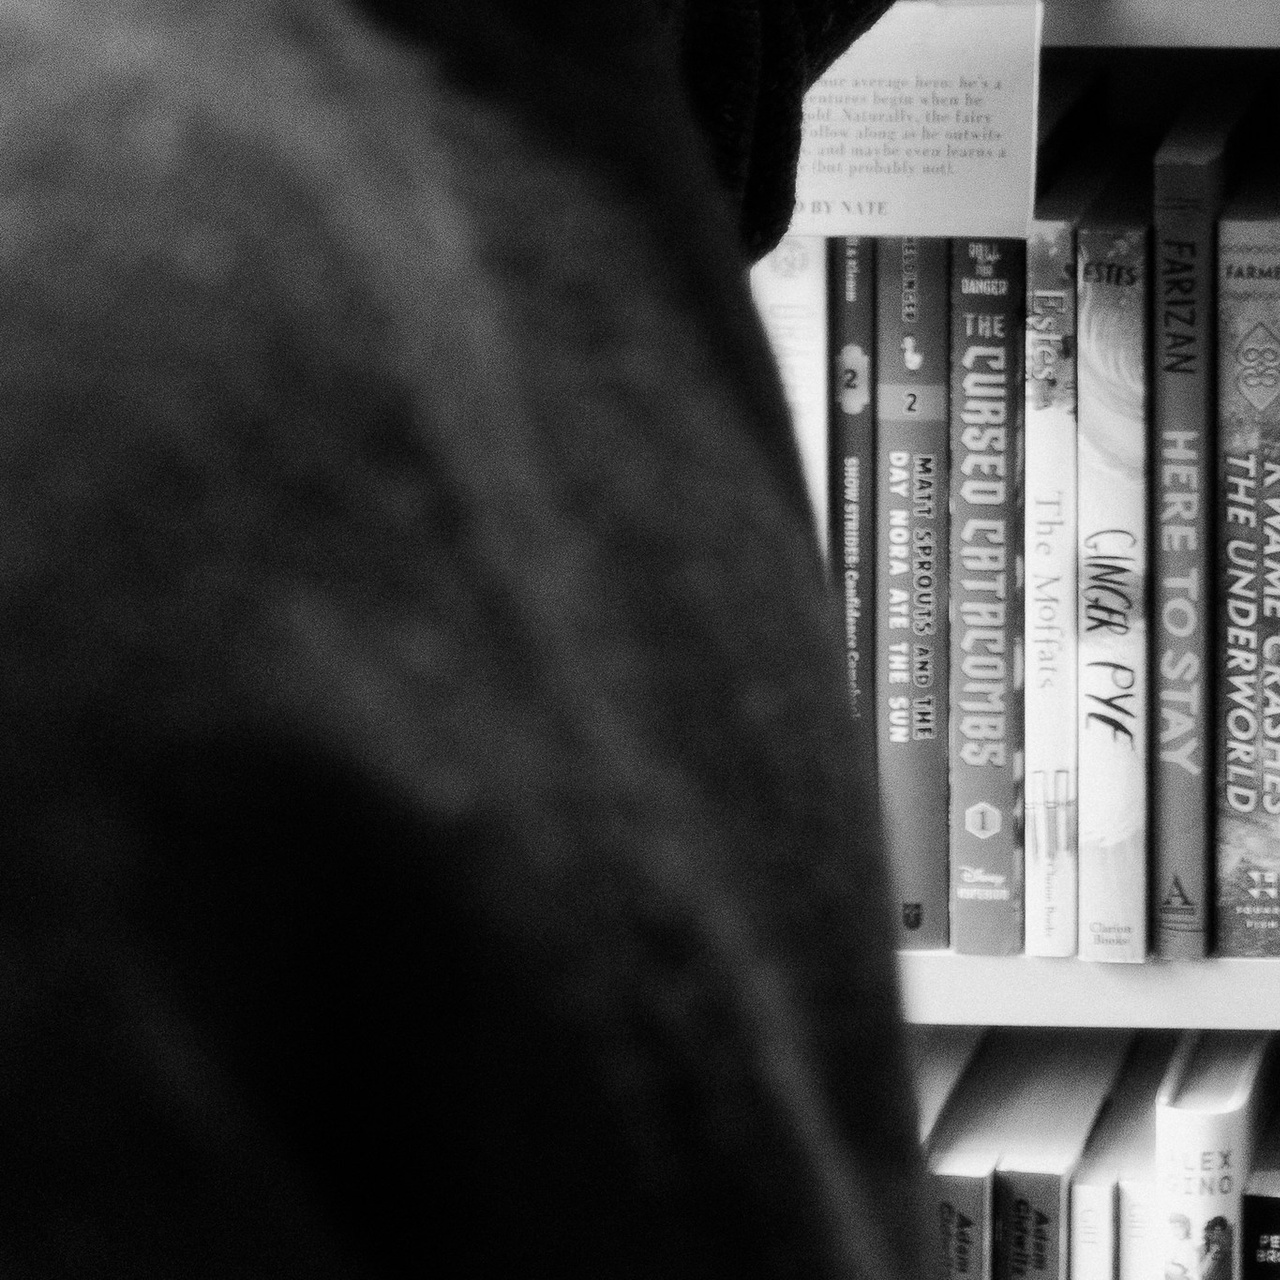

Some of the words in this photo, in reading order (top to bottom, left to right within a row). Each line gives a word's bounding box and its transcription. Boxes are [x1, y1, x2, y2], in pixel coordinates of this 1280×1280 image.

[841, 200, 889, 215] NATE
[966, 314, 1005, 339] THE
[1163, 240, 1197, 375] FARIZAN
[906, 393, 917, 412] 2
[961, 346, 1006, 504] CURSED
[888, 450, 909, 498] DAY
[914, 454, 934, 519] MATT
[1161, 430, 1198, 552] HERE
[1226, 454, 1257, 528] THE
[888, 510, 909, 576] NORA
[913, 528, 935, 637] SPROUTS
[1161, 568, 1198, 638] TO
[888, 642, 910, 684] THE
[1033, 574, 1063, 689] Moffats
[913, 643, 935, 688] AND
[1226, 540, 1258, 813] UNDERWORLD
[888, 697, 910, 743] SUN
[913, 695, 935, 740] THE
[1160, 648, 1200, 775] STAY
